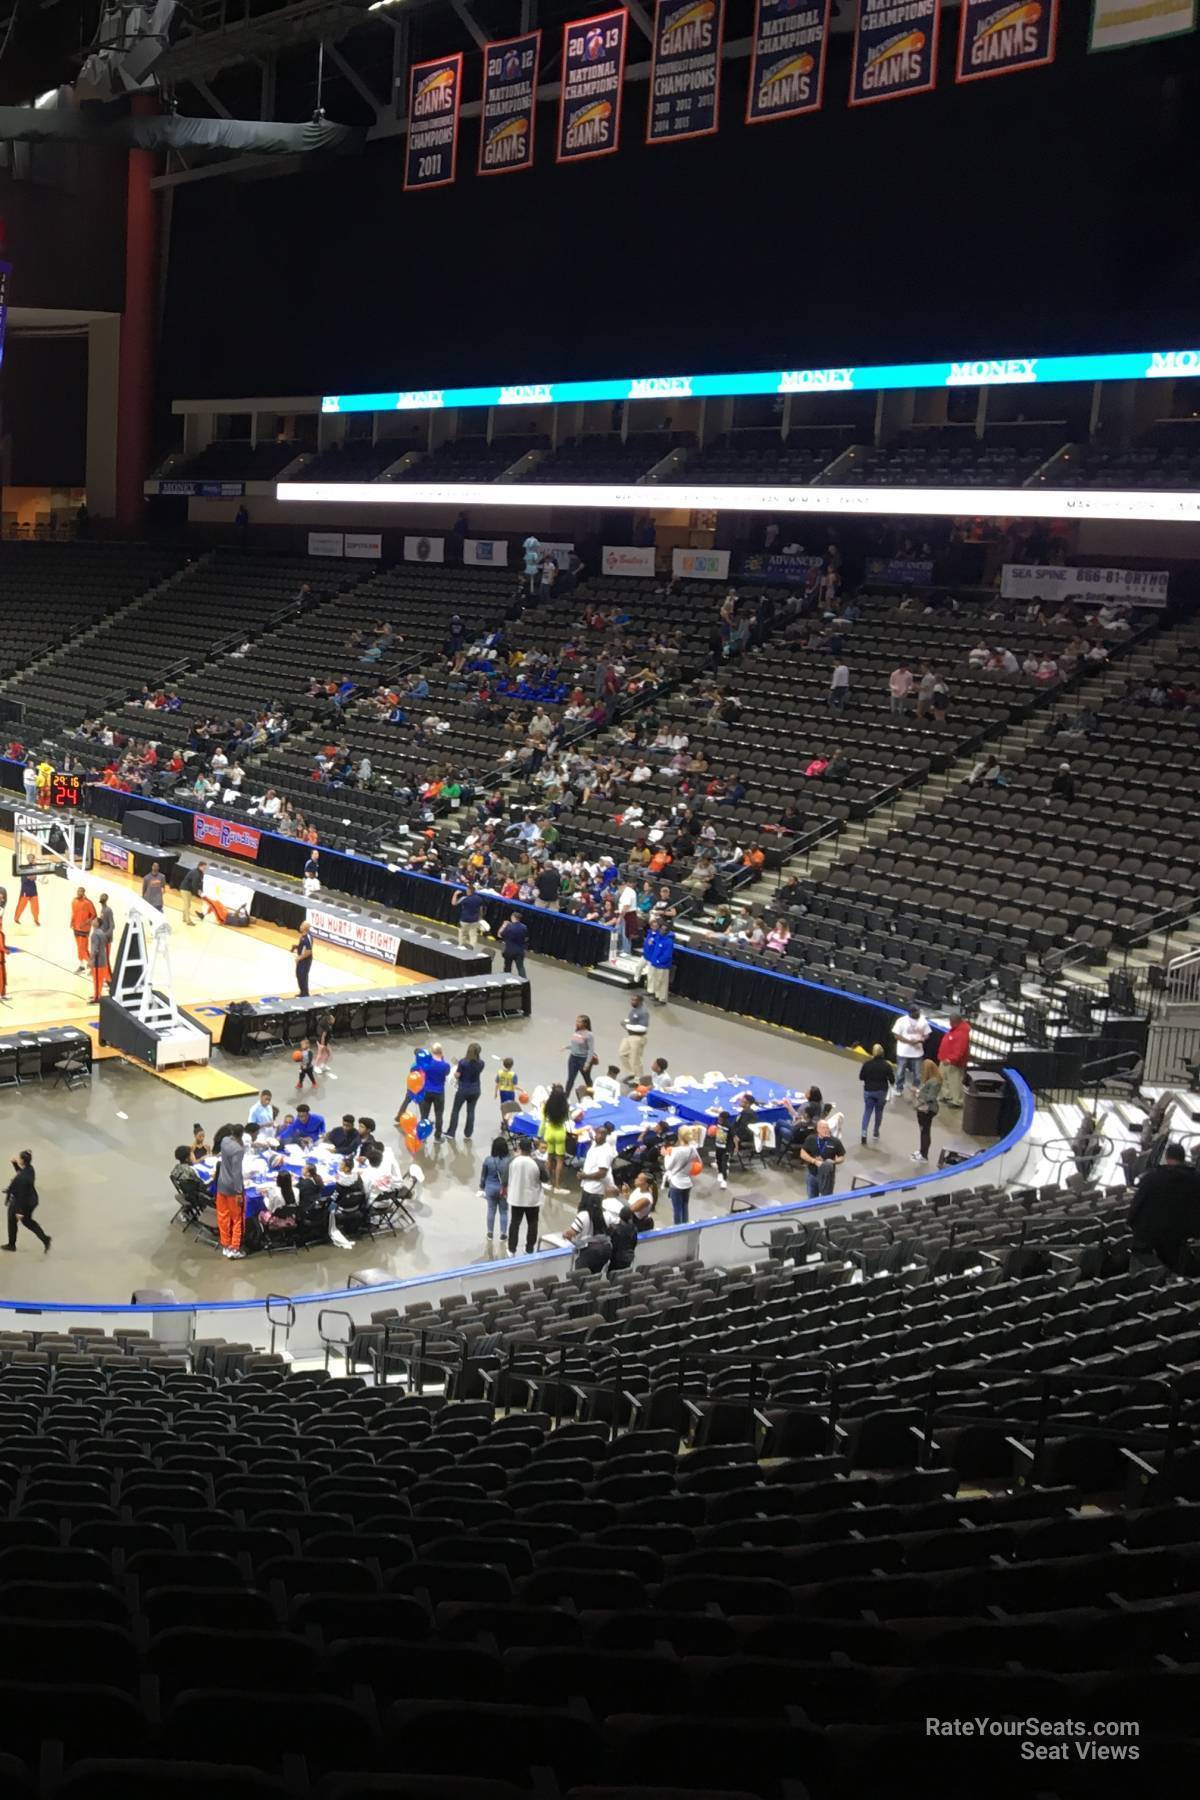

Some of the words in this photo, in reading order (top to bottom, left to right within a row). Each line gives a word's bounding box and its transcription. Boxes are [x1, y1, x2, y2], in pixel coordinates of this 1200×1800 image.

[568, 37, 585, 57] 20
[604, 28, 620, 48] 13
[660, 20, 712, 56] GIANTS
[757, 25, 823, 55] CHAMPIONS
[971, 22, 1040, 65] GIANTS
[488, 57, 503, 77] 20
[521, 49, 535, 69] 12
[568, 60, 617, 84] NATIONAL
[862, 50, 922, 91] GIANTS
[655, 67, 716, 97] CHAMPIONS
[758, 73, 810, 109] GIANTS
[414, 87, 453, 116] GIANTS
[565, 116, 609, 149] GIANTS
[484, 130, 527, 164] GIANTS
[418, 153, 442, 178] 2011
[781, 367, 856, 386] MONEY
[950, 359, 1039, 379] MONEY
[500, 384, 555, 401] MONEY
[631, 376, 693, 393] MONEY
[768, 556, 824, 568] ADVANCED
[53, 775, 79, 787] 29:16
[56, 786, 77, 805] 24
[311, 912, 324, 928] YOU
